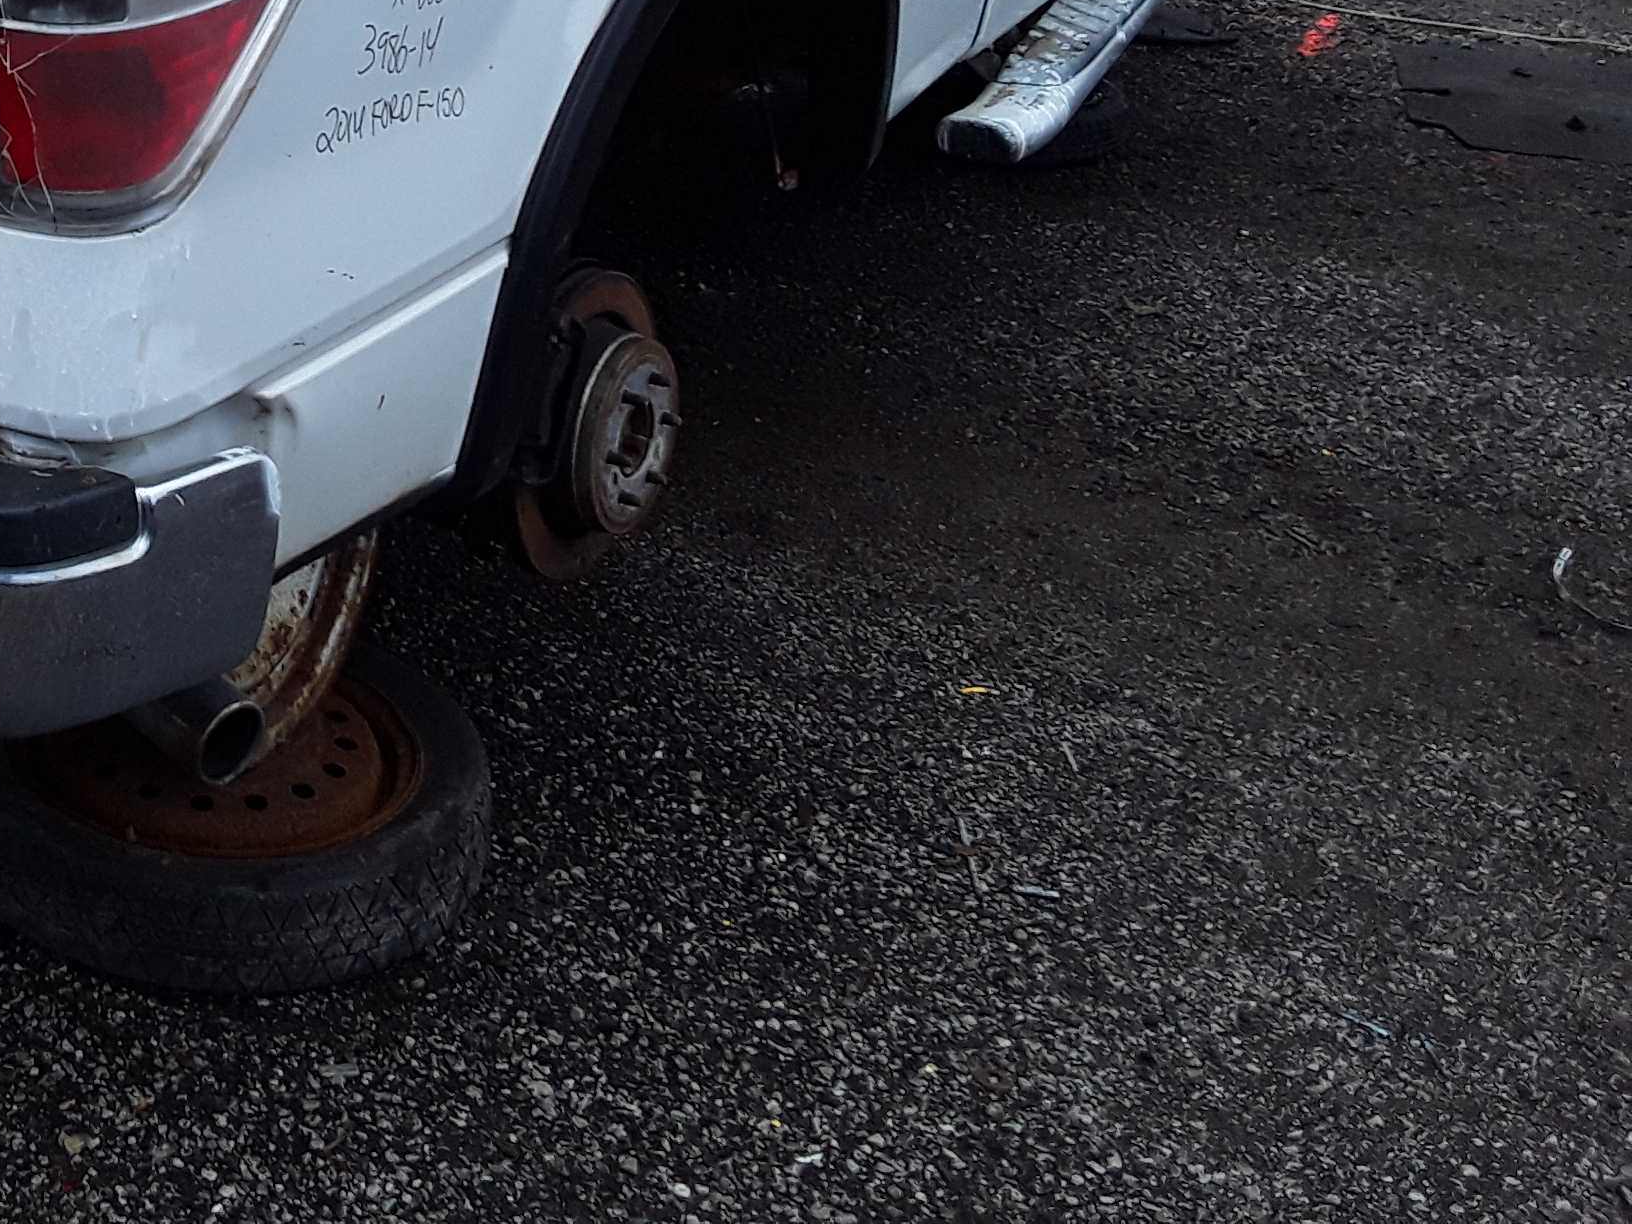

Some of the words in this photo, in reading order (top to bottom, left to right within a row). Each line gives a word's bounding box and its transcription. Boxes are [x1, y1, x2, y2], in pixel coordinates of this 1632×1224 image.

[357, 17, 445, 76] 3986-14
[371, 92, 412, 137] FORD
[416, 86, 466, 123] F-150
